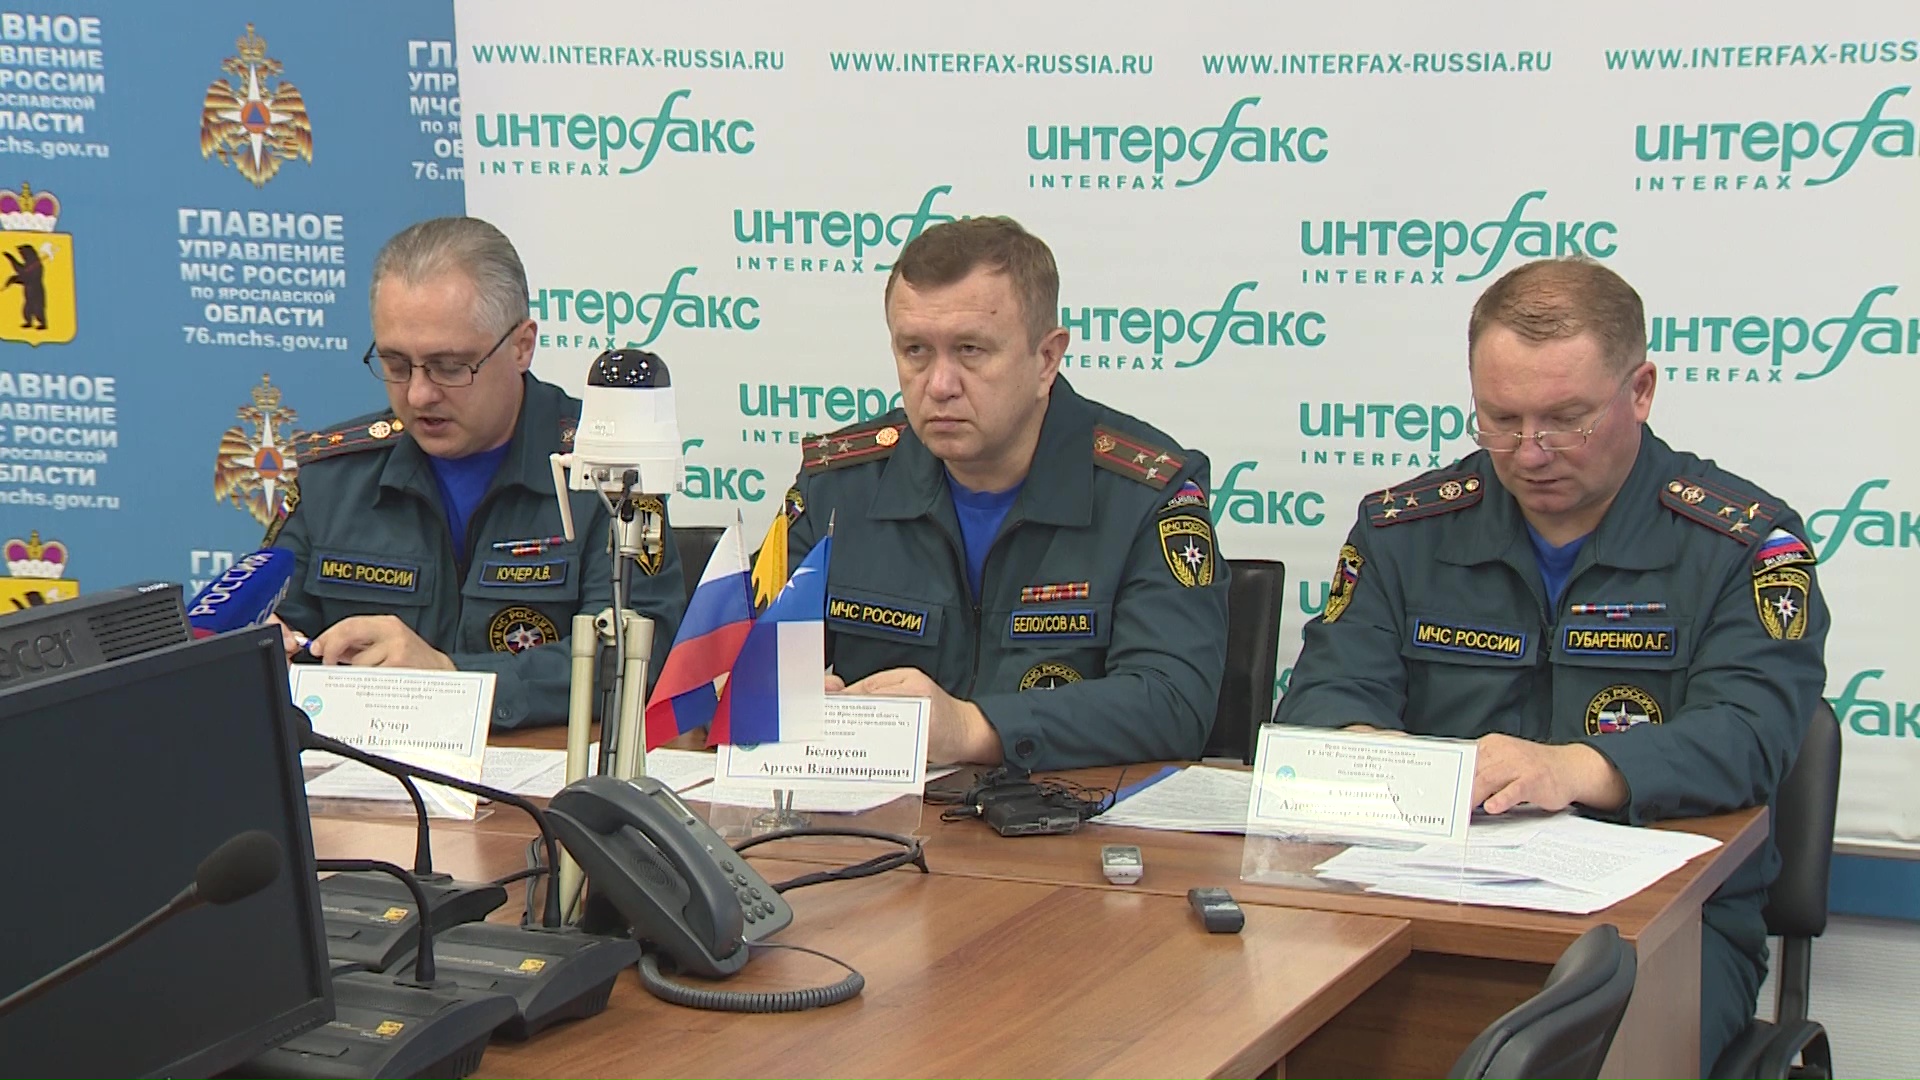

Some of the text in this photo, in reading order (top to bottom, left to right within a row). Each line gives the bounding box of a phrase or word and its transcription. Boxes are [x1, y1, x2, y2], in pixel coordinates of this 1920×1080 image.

[0, 12, 102, 45] ВНОЕ
[472, 45, 786, 71] WWW.INTERFAX-RUSSIA.RU
[829, 52, 1154, 75] WWW.INTERFAX-RUSSIA.RU
[1202, 50, 1553, 75] WWW.INTERFAX-RUSSIA.RU
[0, 69, 105, 94] РОССИИ
[1634, 85, 1920, 187] интерфа
[480, 160, 610, 176] INTERFAX
[1029, 174, 1164, 190] INTERFAX
[1634, 175, 1792, 191] INTERFAX
[178, 208, 344, 241] ГЛАВНОЕ
[178, 239, 345, 264] УПРАВЛЕНИЕ
[180, 262, 346, 288] МЧС РОССИИ
[736, 256, 864, 273] INTERFAX
[1302, 270, 1444, 285] INTERFAX
[190, 286, 336, 304] ПО ЯРОСЛАВСКОЙ
[204, 303, 325, 328] ОБЛАСТИ
[182, 326, 348, 352] 76.mchs.gov.ru
[1665, 367, 1783, 383] TERFAX
[739, 383, 902, 424] интер
[14, 425, 119, 448] РОССИИ
[1300, 403, 1476, 454] интер
[1301, 451, 1441, 468] INTERFAX
[322, 561, 413, 586] МЧС РОССИИ
[496, 566, 533, 582] КУЧЕР
[830, 600, 923, 631] МЧС РОССИИ
[1013, 614, 1091, 633] БЕЛОУСОВ А.В.
[1418, 625, 1522, 655] МЧС РОССИИ
[1568, 631, 1670, 650] ГУБАРЕНКО А.Г.
[369, 717, 409, 734] Кучер
[367, 735, 464, 751] Владимирович
[805, 745, 867, 758] Белоусов
[759, 761, 910, 780] Артем Владимирович
